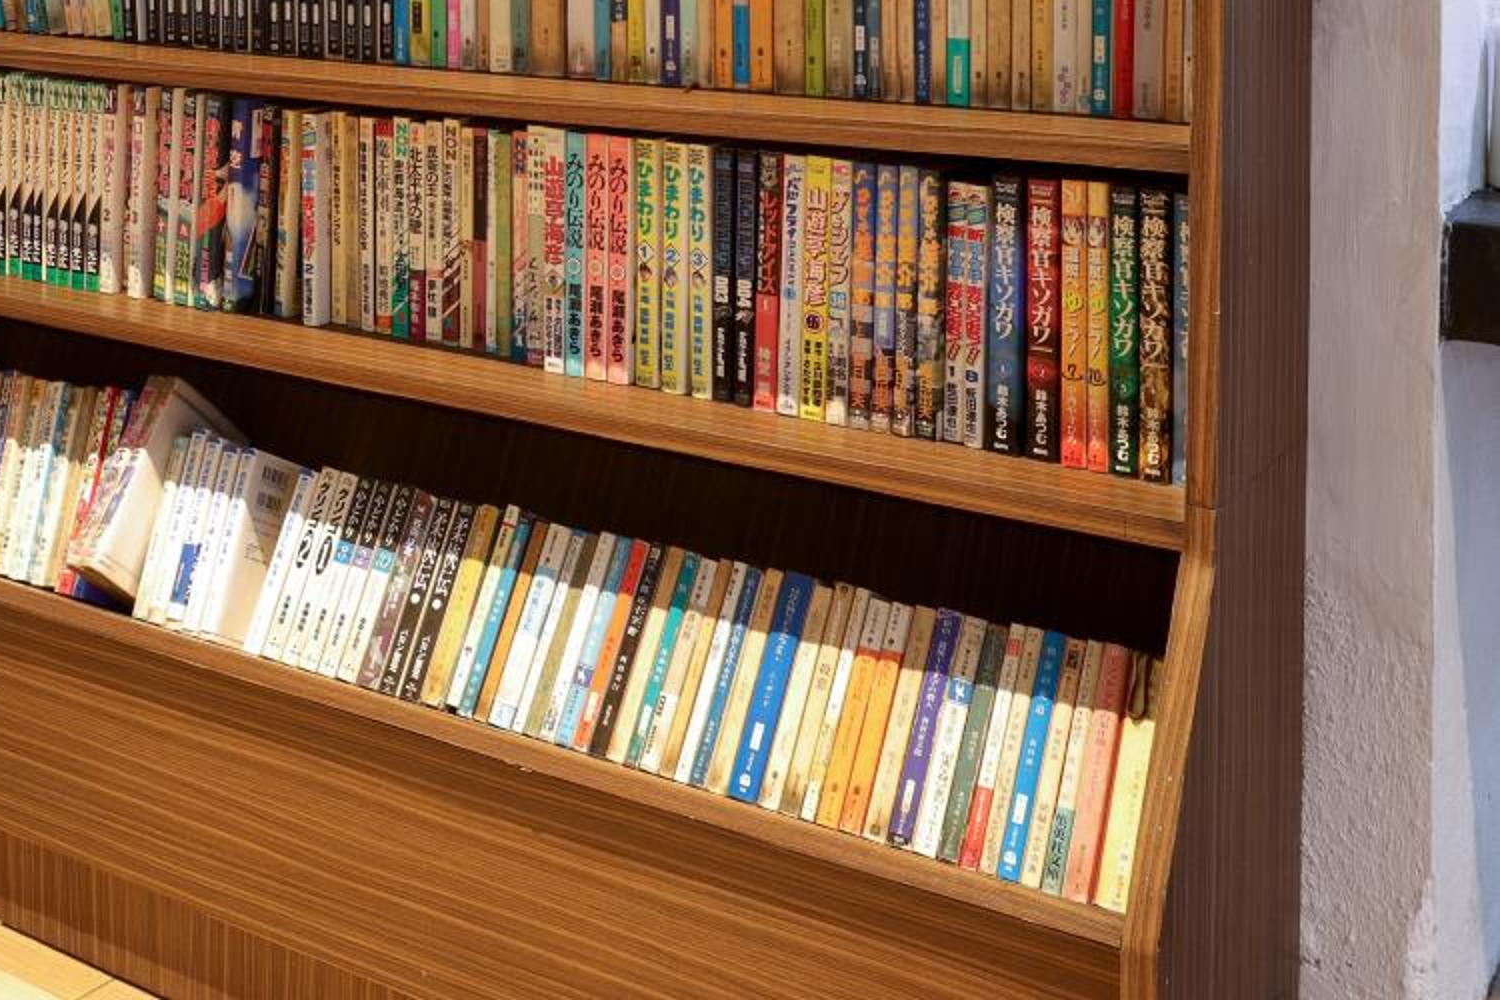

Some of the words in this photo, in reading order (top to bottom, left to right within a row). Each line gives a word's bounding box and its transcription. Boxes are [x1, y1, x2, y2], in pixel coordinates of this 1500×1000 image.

[396, 124, 407, 156] NON
[445, 126, 457, 161] NON
[567, 153, 583, 248] みのり伝説
[588, 154, 604, 251] みのり伝説
[610, 157, 627, 255] みのり伝説
[638, 162, 653, 235] ひまわり
[665, 165, 680, 240] ひまわり
[691, 167, 705, 243] ひまわり
[764, 191, 777, 294] レッドアイズ
